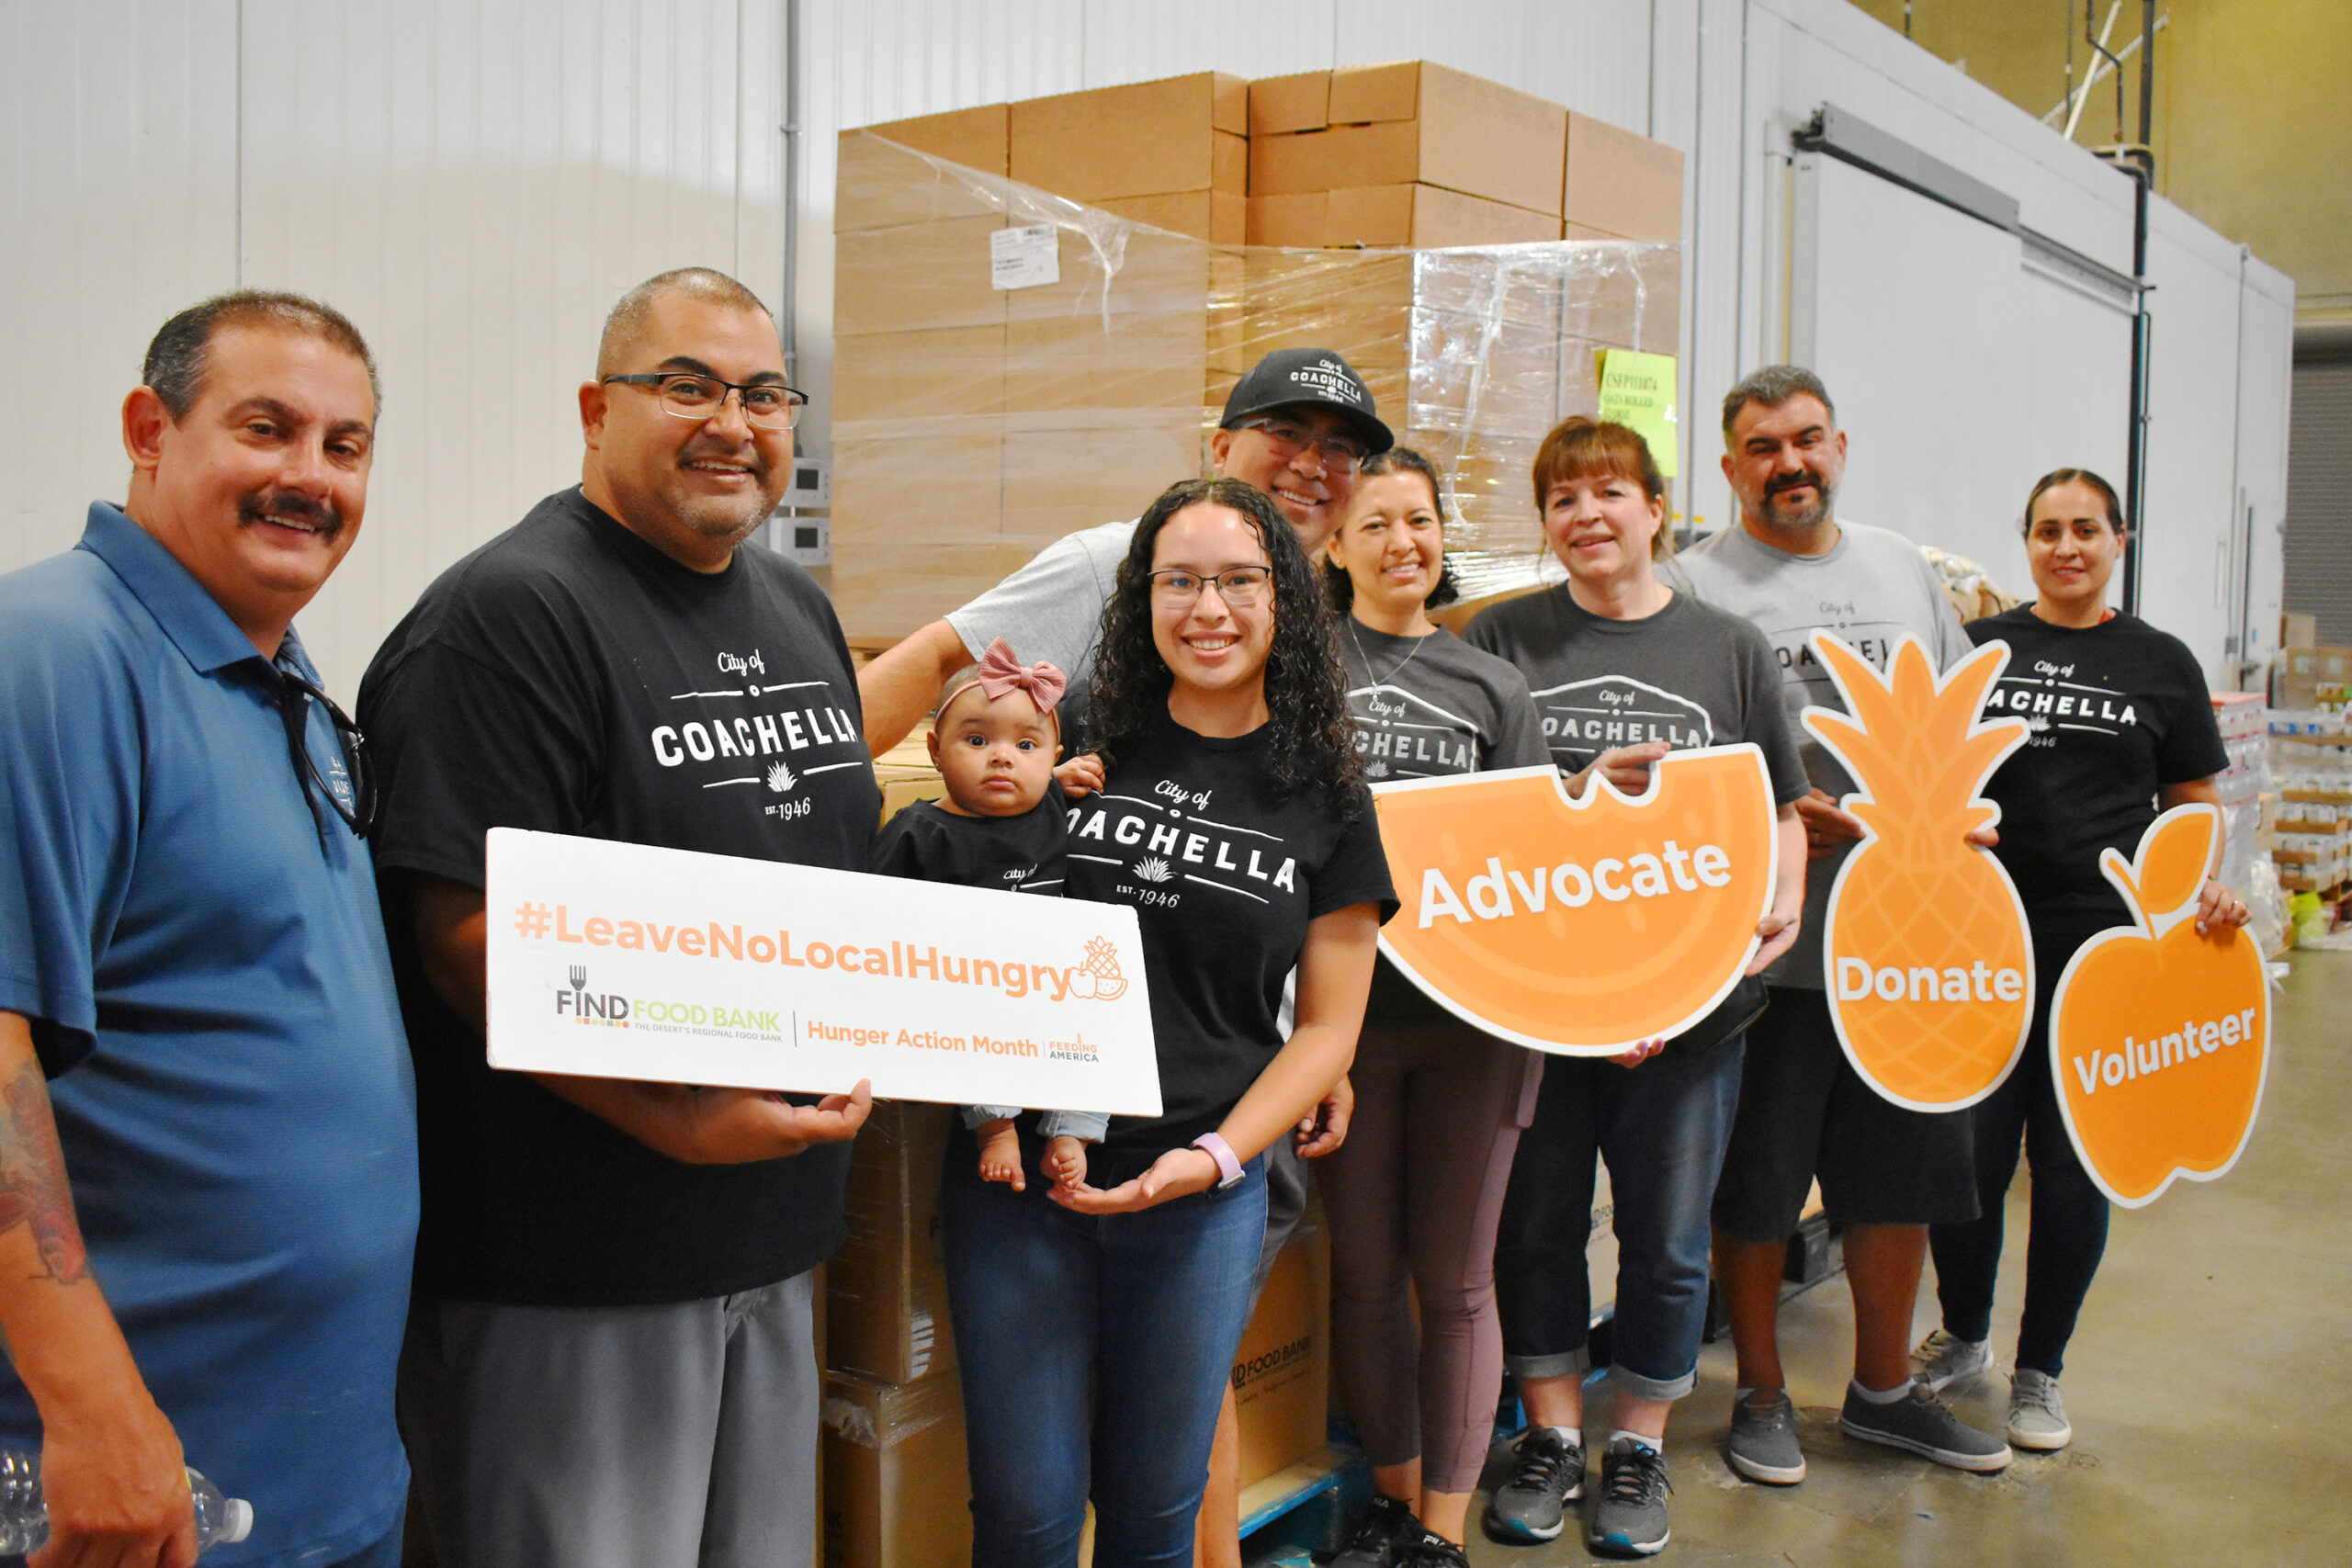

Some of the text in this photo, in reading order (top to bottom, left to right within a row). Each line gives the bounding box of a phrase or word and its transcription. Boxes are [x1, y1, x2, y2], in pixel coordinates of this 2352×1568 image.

[1290, 372, 1362, 402] COACHELLA
[1820, 601, 1854, 615] City of
[718, 649, 764, 676] City of
[2034, 660, 2075, 678] City of
[1369, 700, 1407, 717] City of
[1599, 690, 1635, 705] City of
[1986, 689, 2137, 727] ACHELLA
[650, 707, 858, 767] COACHELLA
[1541, 716, 1702, 749] OACHELLA
[1351, 729, 1467, 769] CHELLA
[779, 797, 810, 820] 1946
[1154, 780, 1212, 810] City of
[1067, 807, 1296, 894] OACHELLA
[1116, 885, 1180, 908] EST. 1946
[1418, 840, 1732, 930] Advocate
[514, 901, 1071, 1002] #LeaveNoLocalHungry
[1837, 956, 2023, 1002] Donate
[557, 989, 781, 1032] FIND FOOD BANK
[635, 1022, 650, 1031] THE
[693, 1028, 733, 1038] REGIONAL
[736, 1032, 758, 1041] FOOD
[761, 1033, 782, 1042] BANK
[808, 1021, 1038, 1057] Hunger Action Month
[1049, 1041, 1098, 1054] FEEDING
[1049, 1051, 1099, 1063] AMERICA
[2073, 1007, 2256, 1095] Volunteer
[1248, 1350, 1281, 1377] FOOD
[1283, 1336, 1312, 1360] BANK
